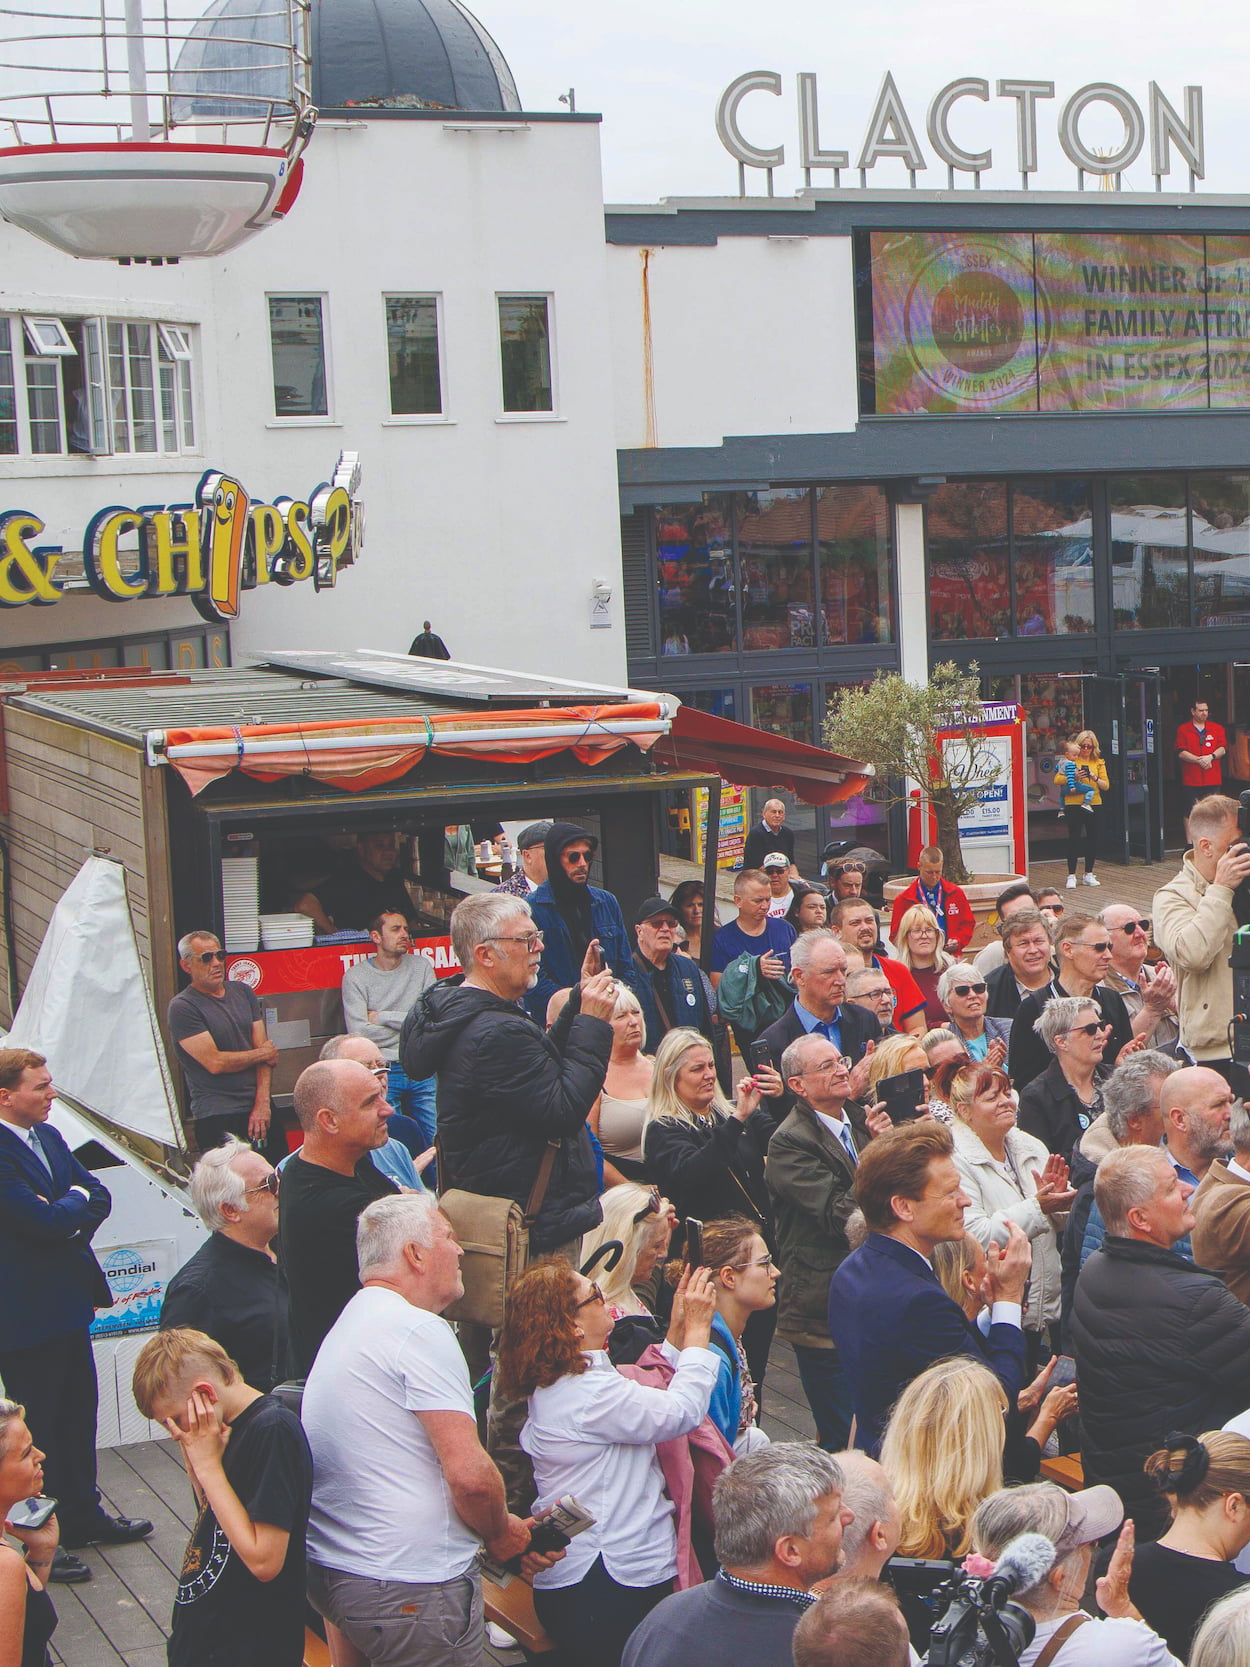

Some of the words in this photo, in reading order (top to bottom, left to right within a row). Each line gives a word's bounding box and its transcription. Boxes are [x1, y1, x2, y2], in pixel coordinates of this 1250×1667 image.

[715, 70, 1203, 178] CLACTON
[1082, 265, 1187, 293] WINNER
[1196, 266, 1226, 293] OF
[1085, 309, 1176, 336] FAMILY
[1087, 352, 1113, 380] IN
[1124, 352, 1193, 380] ESSEX
[943, 369, 986, 392] WINNER
[106, 1261, 155, 1277] ondial
